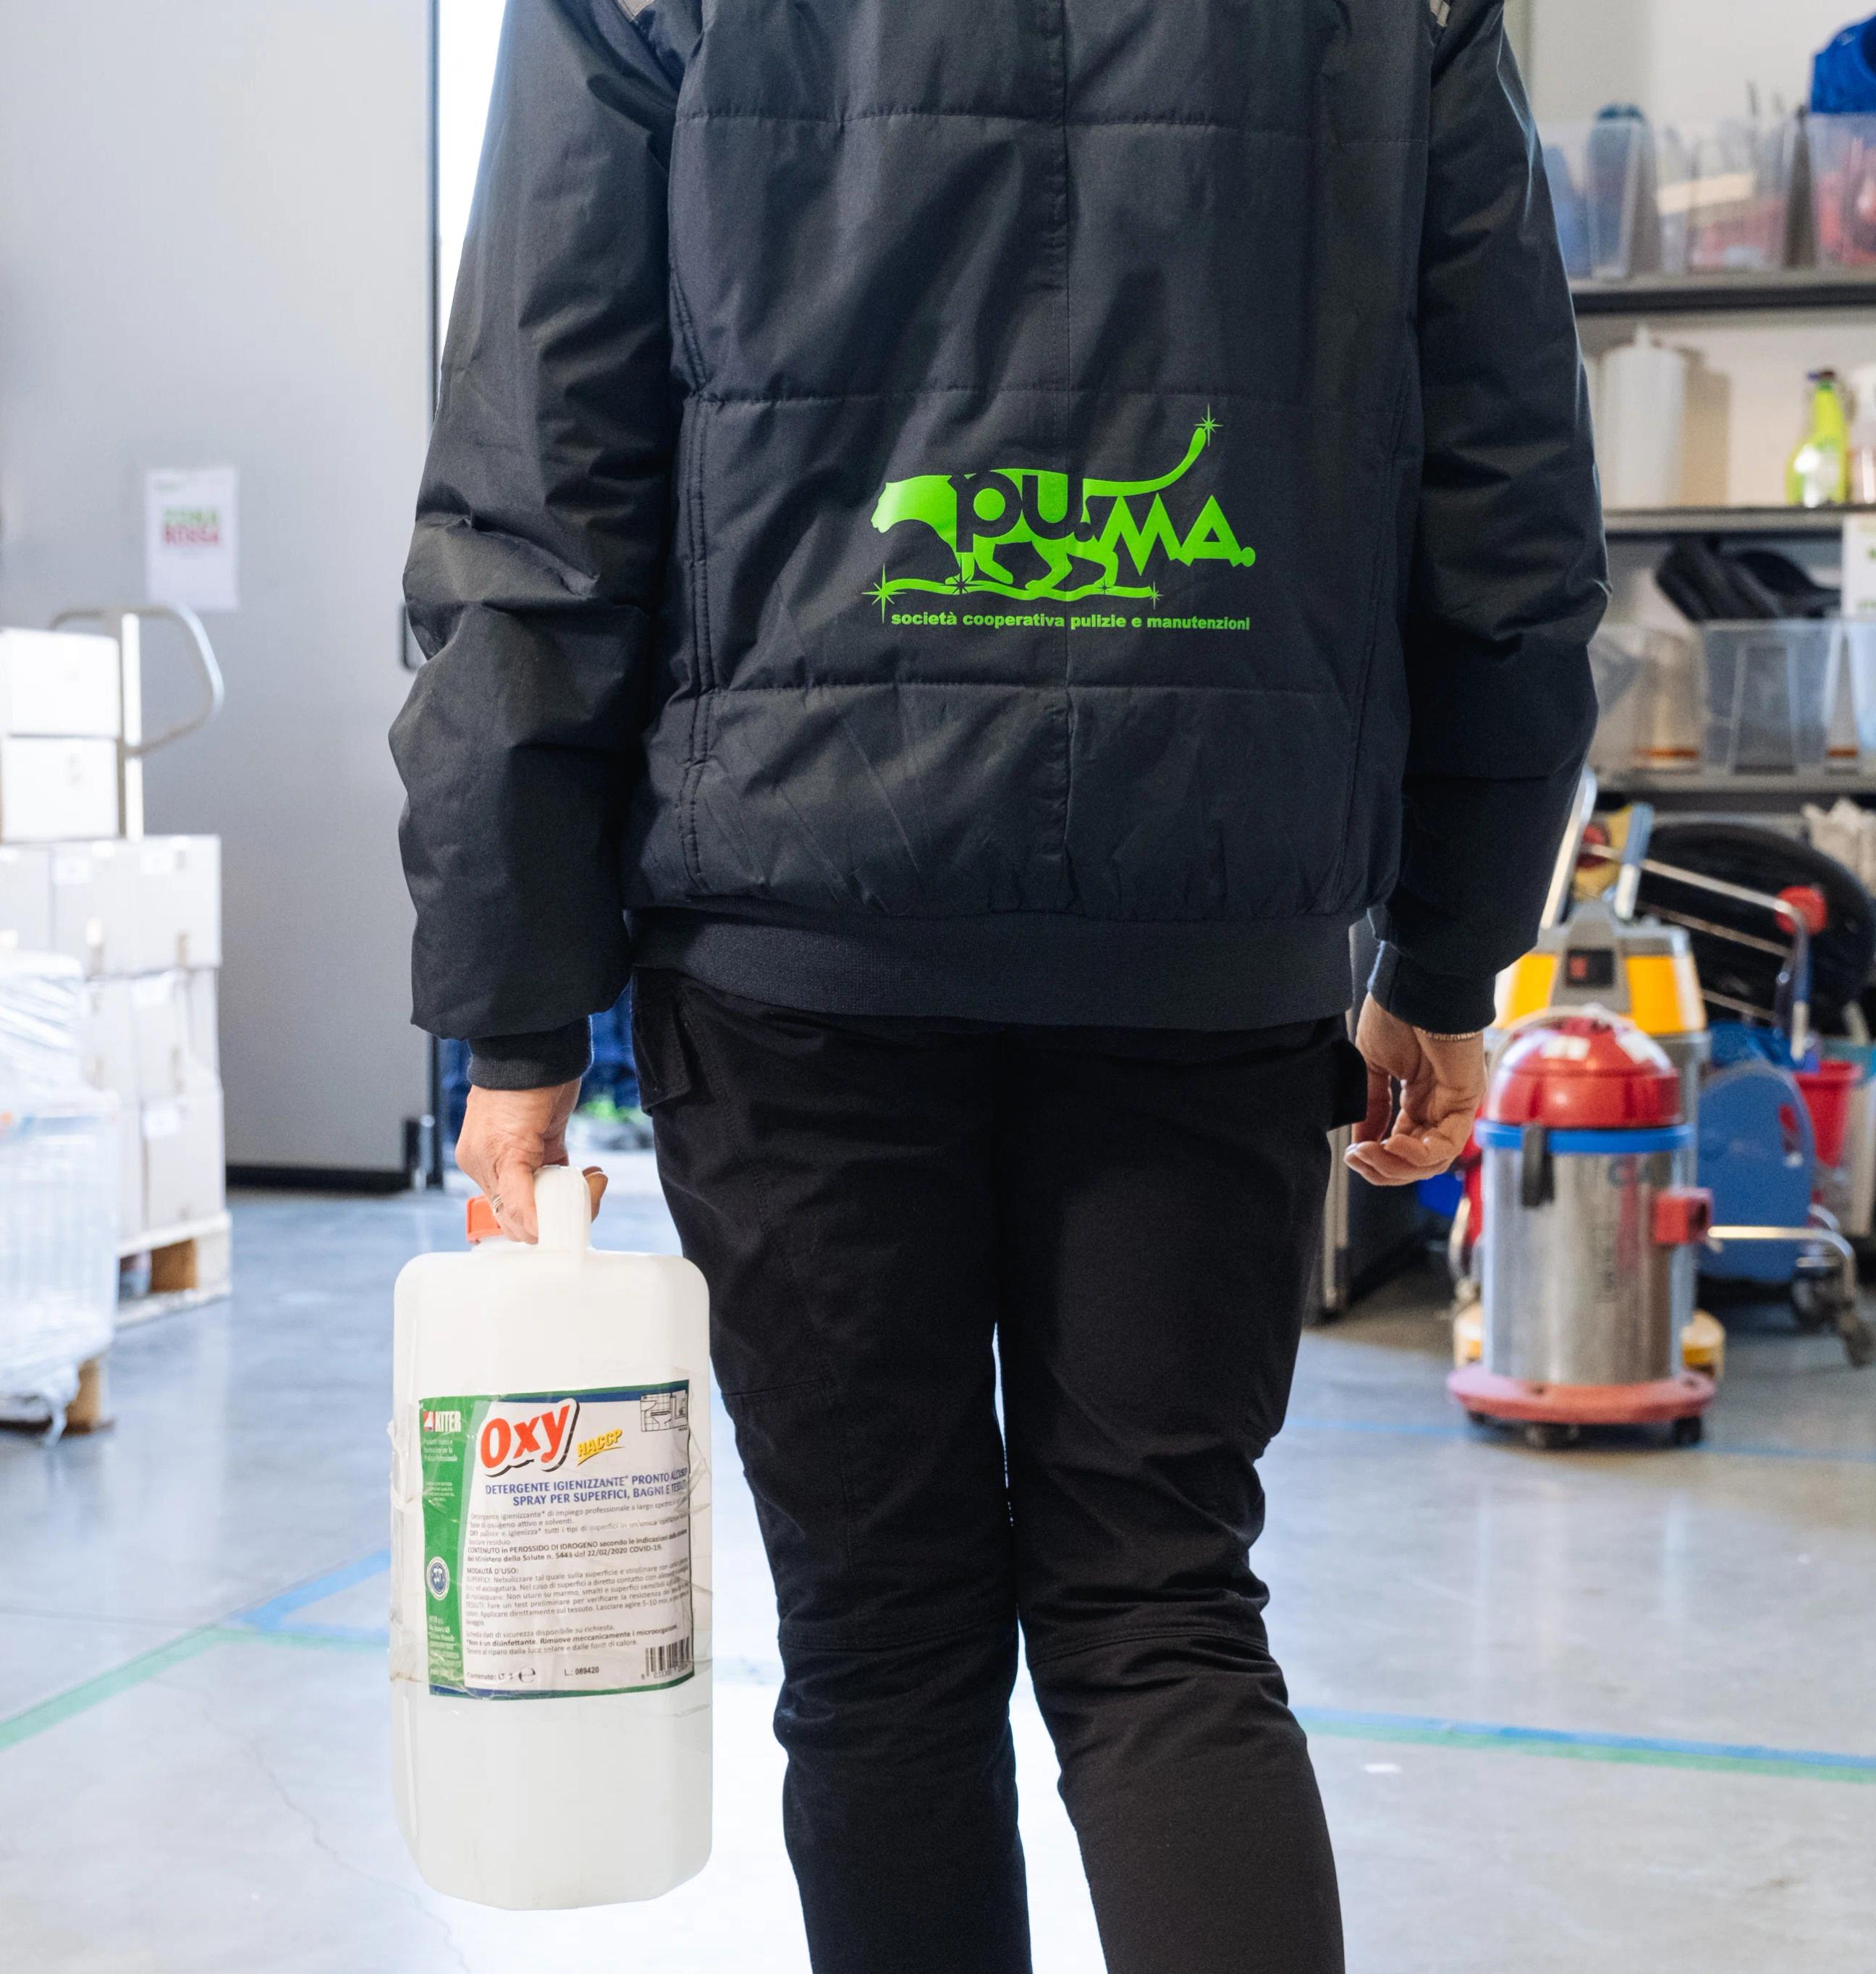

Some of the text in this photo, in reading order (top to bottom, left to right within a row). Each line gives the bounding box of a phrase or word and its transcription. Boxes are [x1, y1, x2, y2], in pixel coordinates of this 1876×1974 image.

[891, 610, 1250, 631] società cooperativa pulizie e manutenzioni
[435, 1411, 461, 1432] KITER
[481, 1405, 570, 1468] Oxy
[578, 1429, 622, 1457] HACCP
[486, 1484, 550, 1494] DETERGENTE
[631, 1473, 669, 1485] PRONTO
[513, 1495, 546, 1506] SPRAY
[551, 1494, 570, 1503] PER
[574, 1490, 630, 1502] SUPERFICI,
[634, 1485, 664, 1497] BAGNI
[666, 1485, 670, 1494] E
[585, 1503, 630, 1515] professionale
[589, 1522, 618, 1532] superfici
[560, 1541, 598, 1550] IDROGENO
[599, 1538, 627, 1547] secondo
[588, 1548, 628, 1556] 22/02/2020
[630, 1544, 662, 1553] COVID-19.
[546, 1572, 565, 1581] quale
[586, 1569, 618, 1579] superficie
[617, 1575, 643, 1584] contatto
[582, 1587, 603, 1595] smalti
[611, 1582, 638, 1593] superfici
[531, 1599, 570, 1608] preliminare
[588, 1595, 619, 1603] verificare
[629, 1590, 661, 1600] resistenza
[510, 1608, 555, 1617] direttamente
[596, 1602, 622, 1611] Lasciare
[536, 1627, 573, 1637] disponibile
[572, 1631, 631, 1642] meccanicamente
